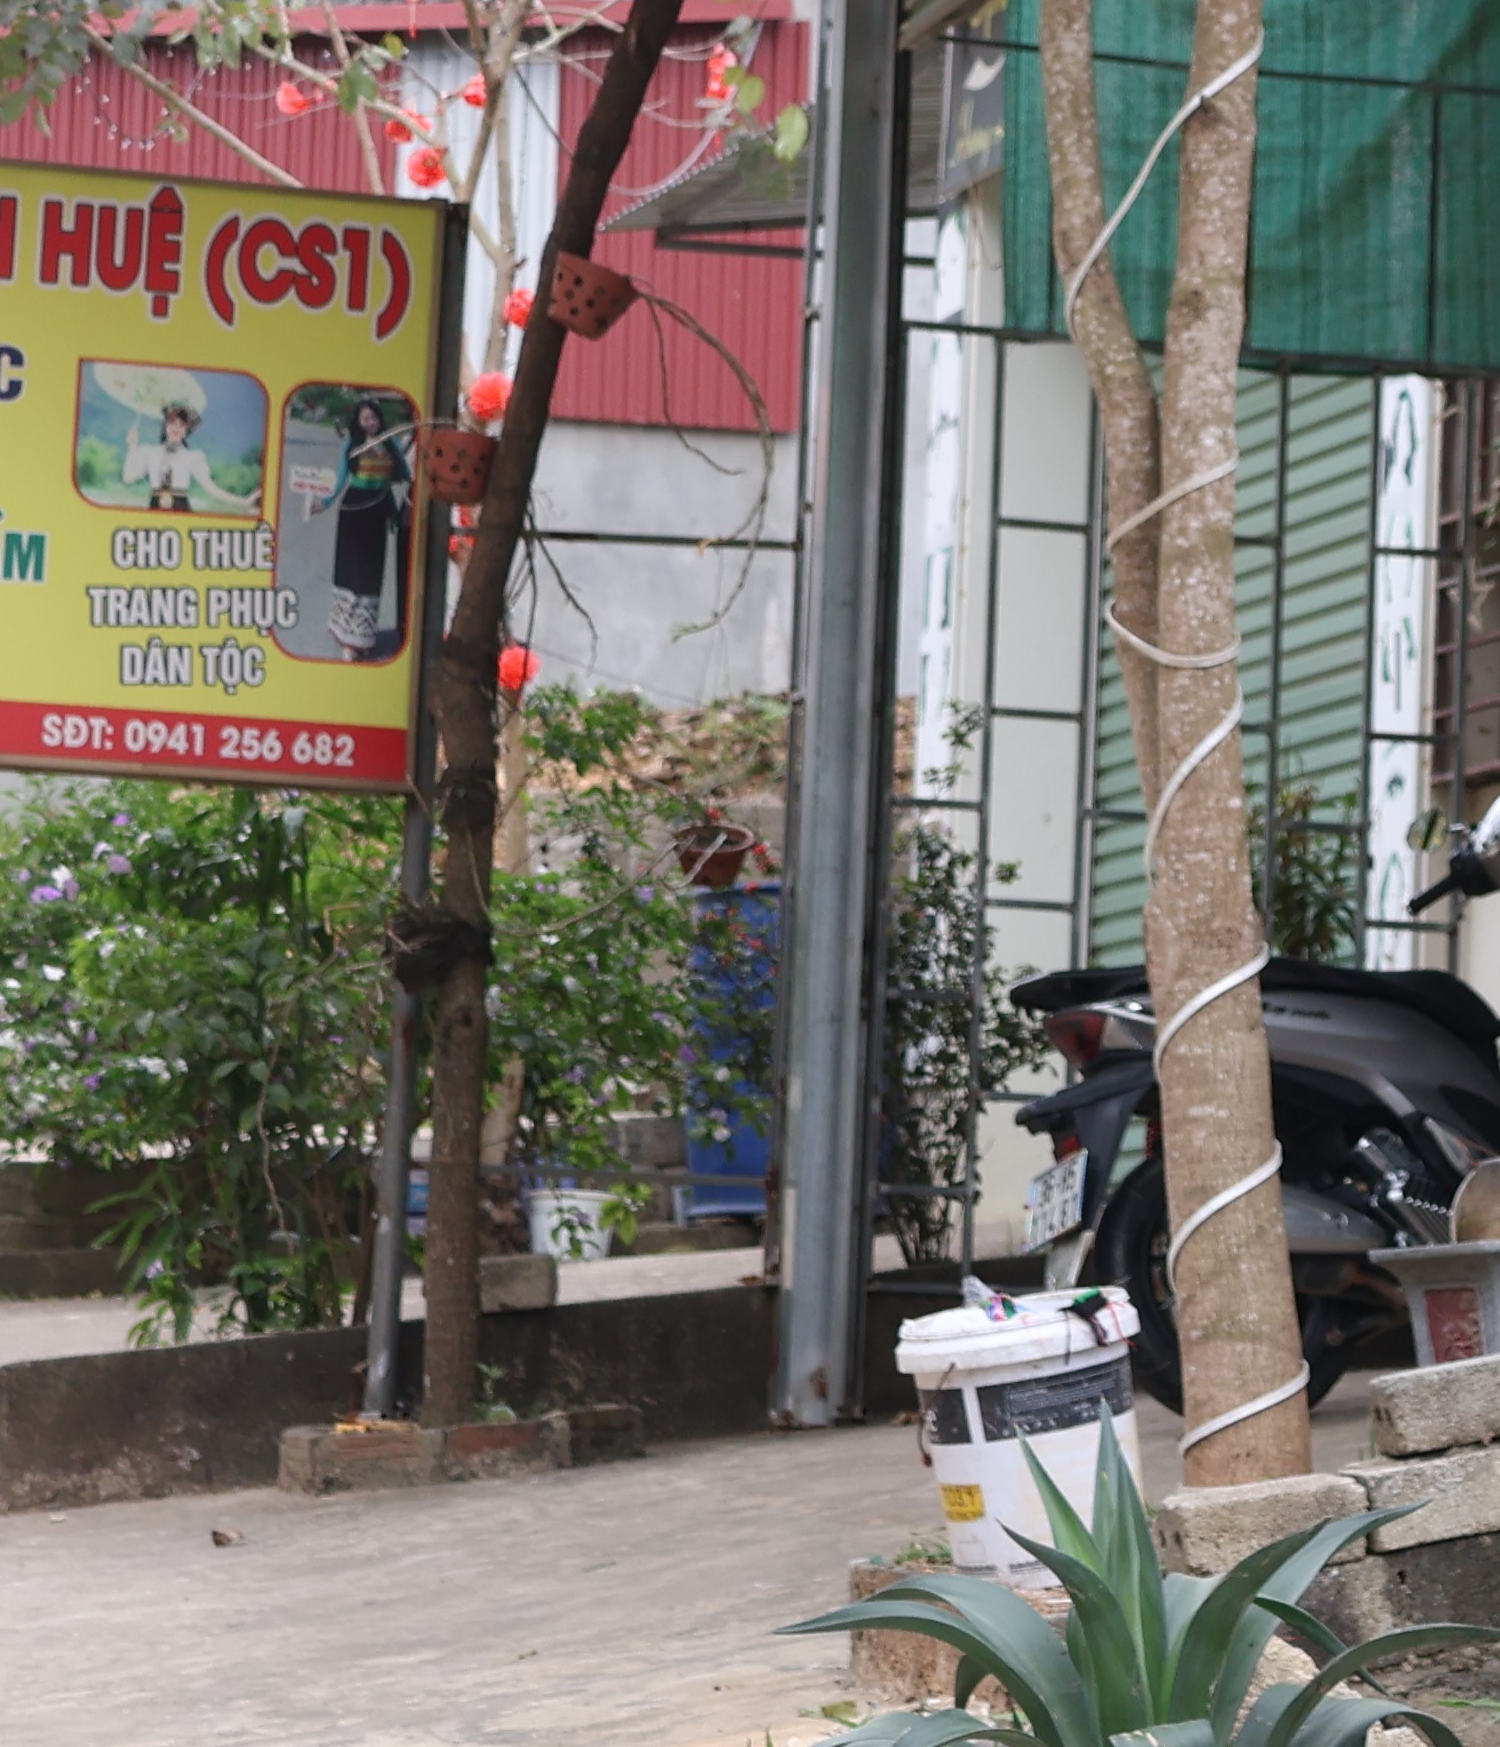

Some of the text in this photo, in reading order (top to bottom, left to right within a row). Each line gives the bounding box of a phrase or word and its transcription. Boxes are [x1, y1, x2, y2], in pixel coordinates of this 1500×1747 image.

[39, 185, 184, 319] HUỆ
[205, 215, 412, 342] (CS1)
[112, 520, 275, 571] CHO THUÊ
[86, 585, 299, 637] TRANG PHỤC
[120, 634, 266, 696] DÂN TỘC
[40, 713, 356, 767] SĐT: 0941 256 682
